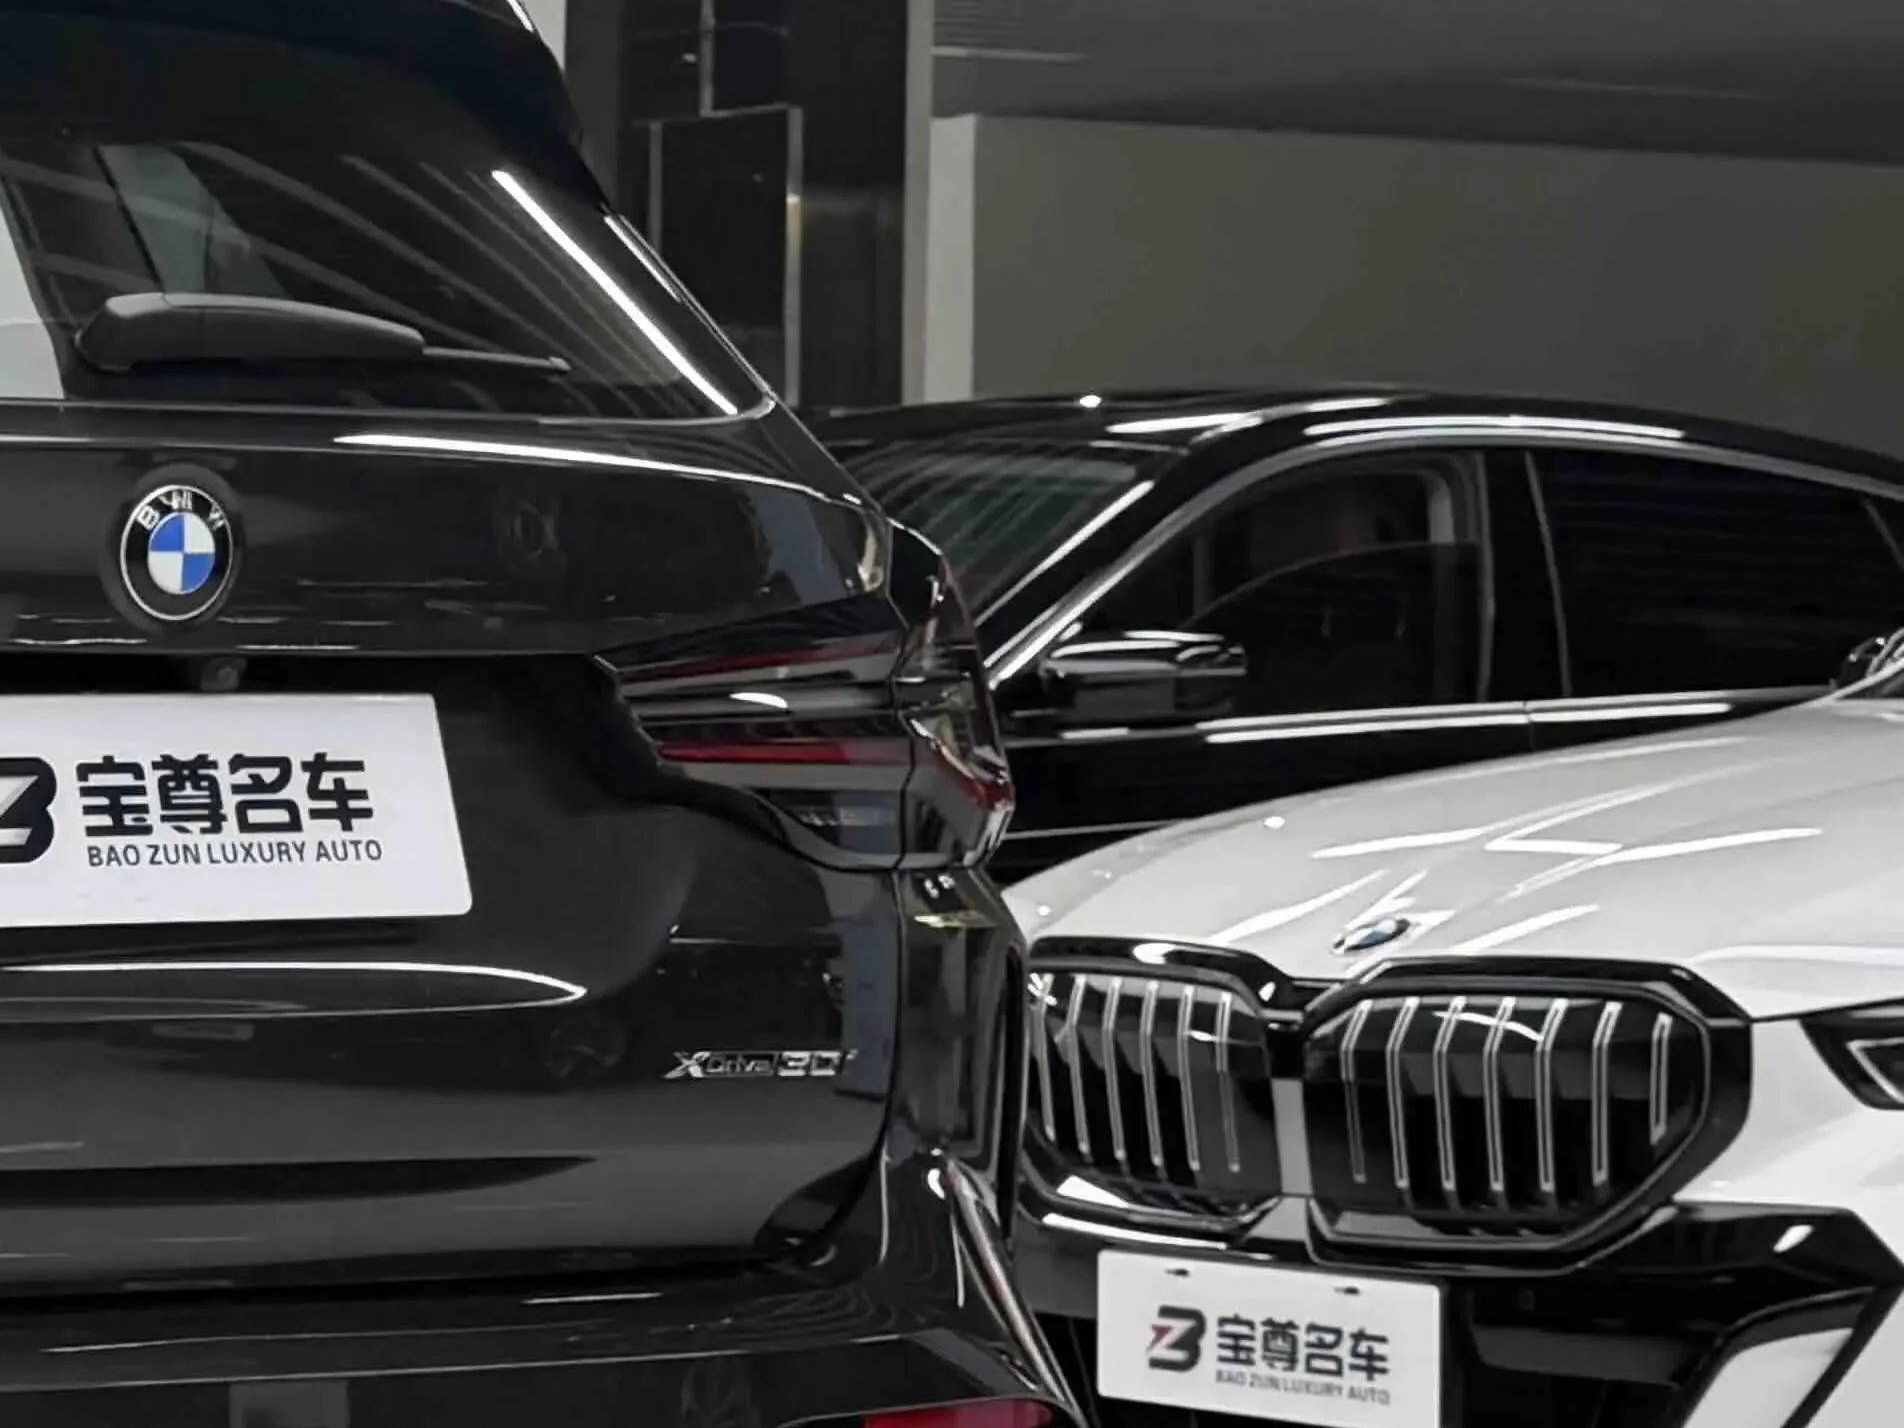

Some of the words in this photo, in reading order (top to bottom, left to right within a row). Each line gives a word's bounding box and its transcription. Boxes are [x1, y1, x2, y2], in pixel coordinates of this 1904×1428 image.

[75, 752, 375, 837] 宝尊名车
[86, 845, 141, 867] BAO
[148, 843, 203, 866] ZUN
[207, 841, 308, 865] LUXURY
[314, 839, 383, 863] AUTO
[1216, 1313, 1392, 1383] 宝尊名车
[1346, 1385, 1391, 1406] AUTO
